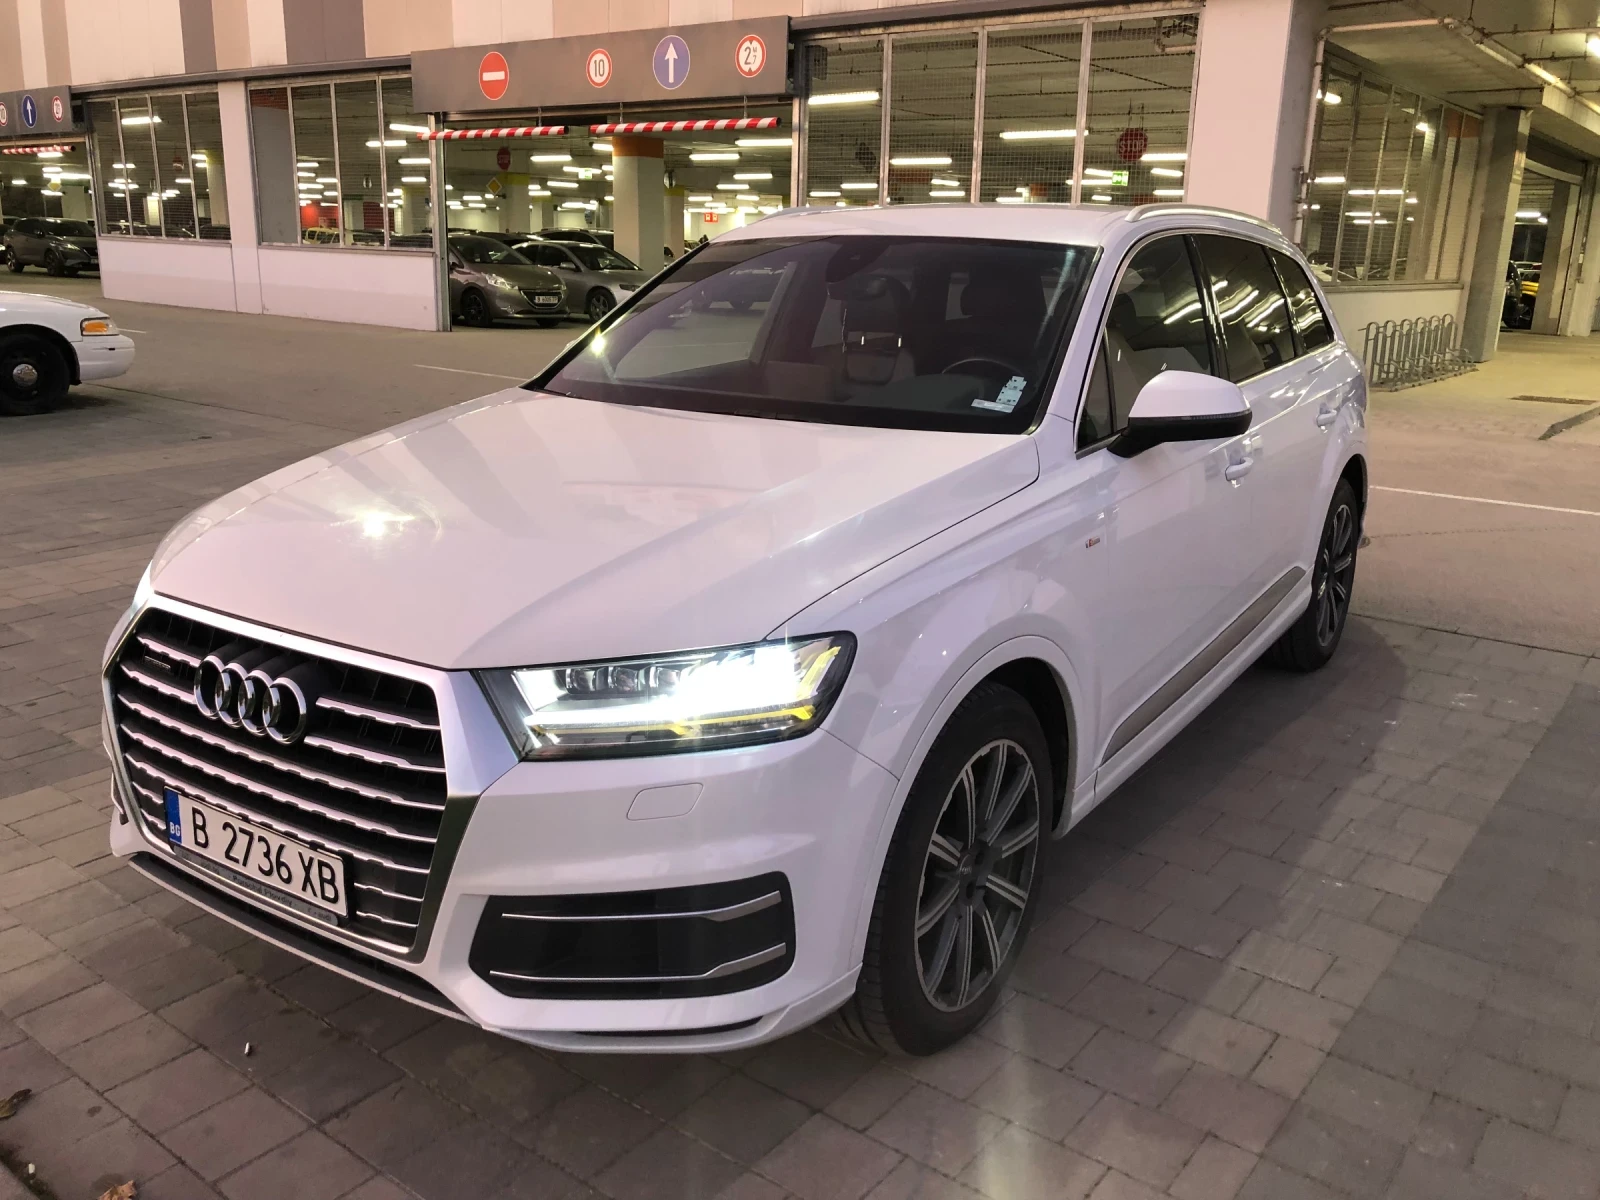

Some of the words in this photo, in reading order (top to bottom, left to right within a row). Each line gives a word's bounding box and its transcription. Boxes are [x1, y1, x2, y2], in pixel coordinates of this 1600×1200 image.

[594, 59, 605, 77] 10
[1119, 140, 1144, 152] STOP
[169, 821, 181, 837] BG
[192, 807, 209, 849] B
[222, 821, 292, 885] 2736
[298, 850, 339, 904] XB
